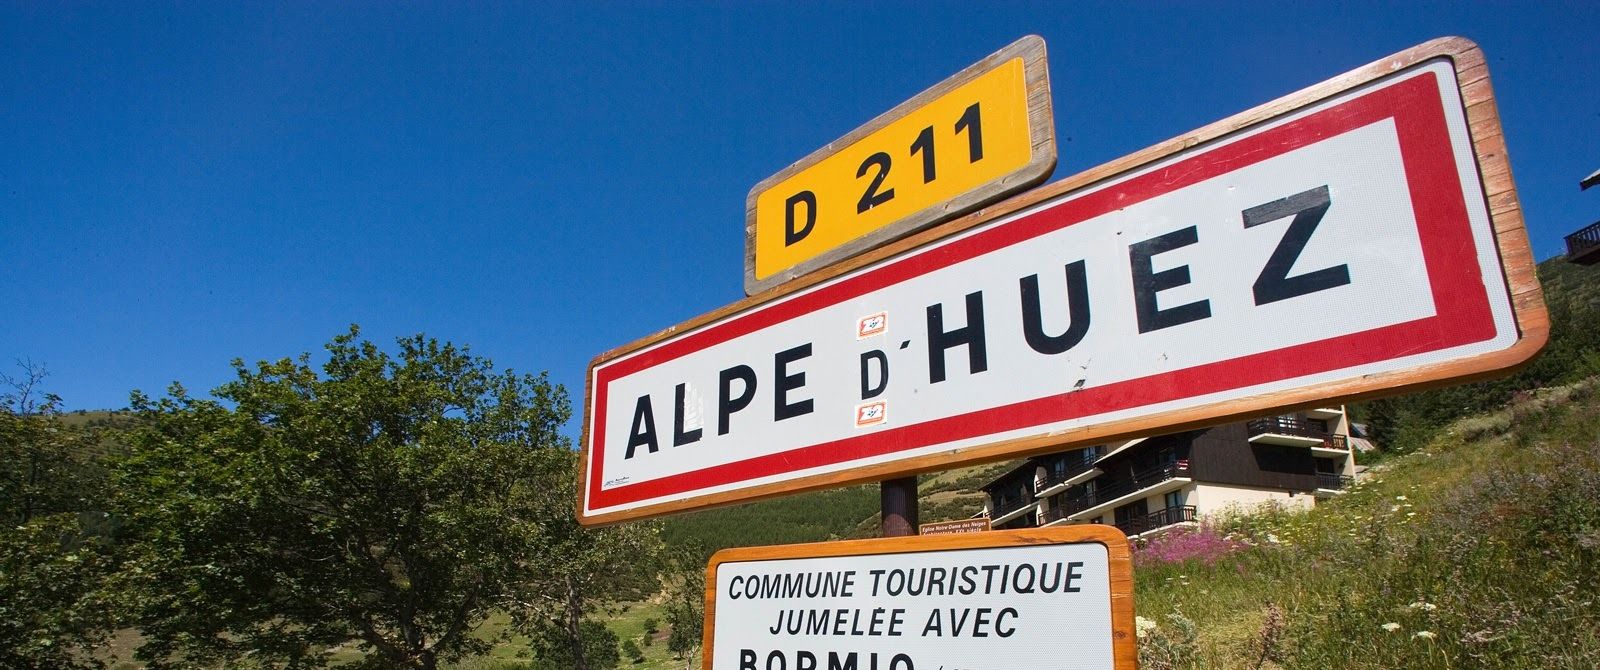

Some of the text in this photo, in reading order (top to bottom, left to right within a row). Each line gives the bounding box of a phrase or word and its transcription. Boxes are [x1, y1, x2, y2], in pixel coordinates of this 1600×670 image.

[784, 101, 984, 248] D 211
[624, 342, 815, 460] ALPE
[728, 561, 1084, 600] COMMUNE TOURISTIQUE
[769, 606, 1019, 639] JUMELÉE AVEC
